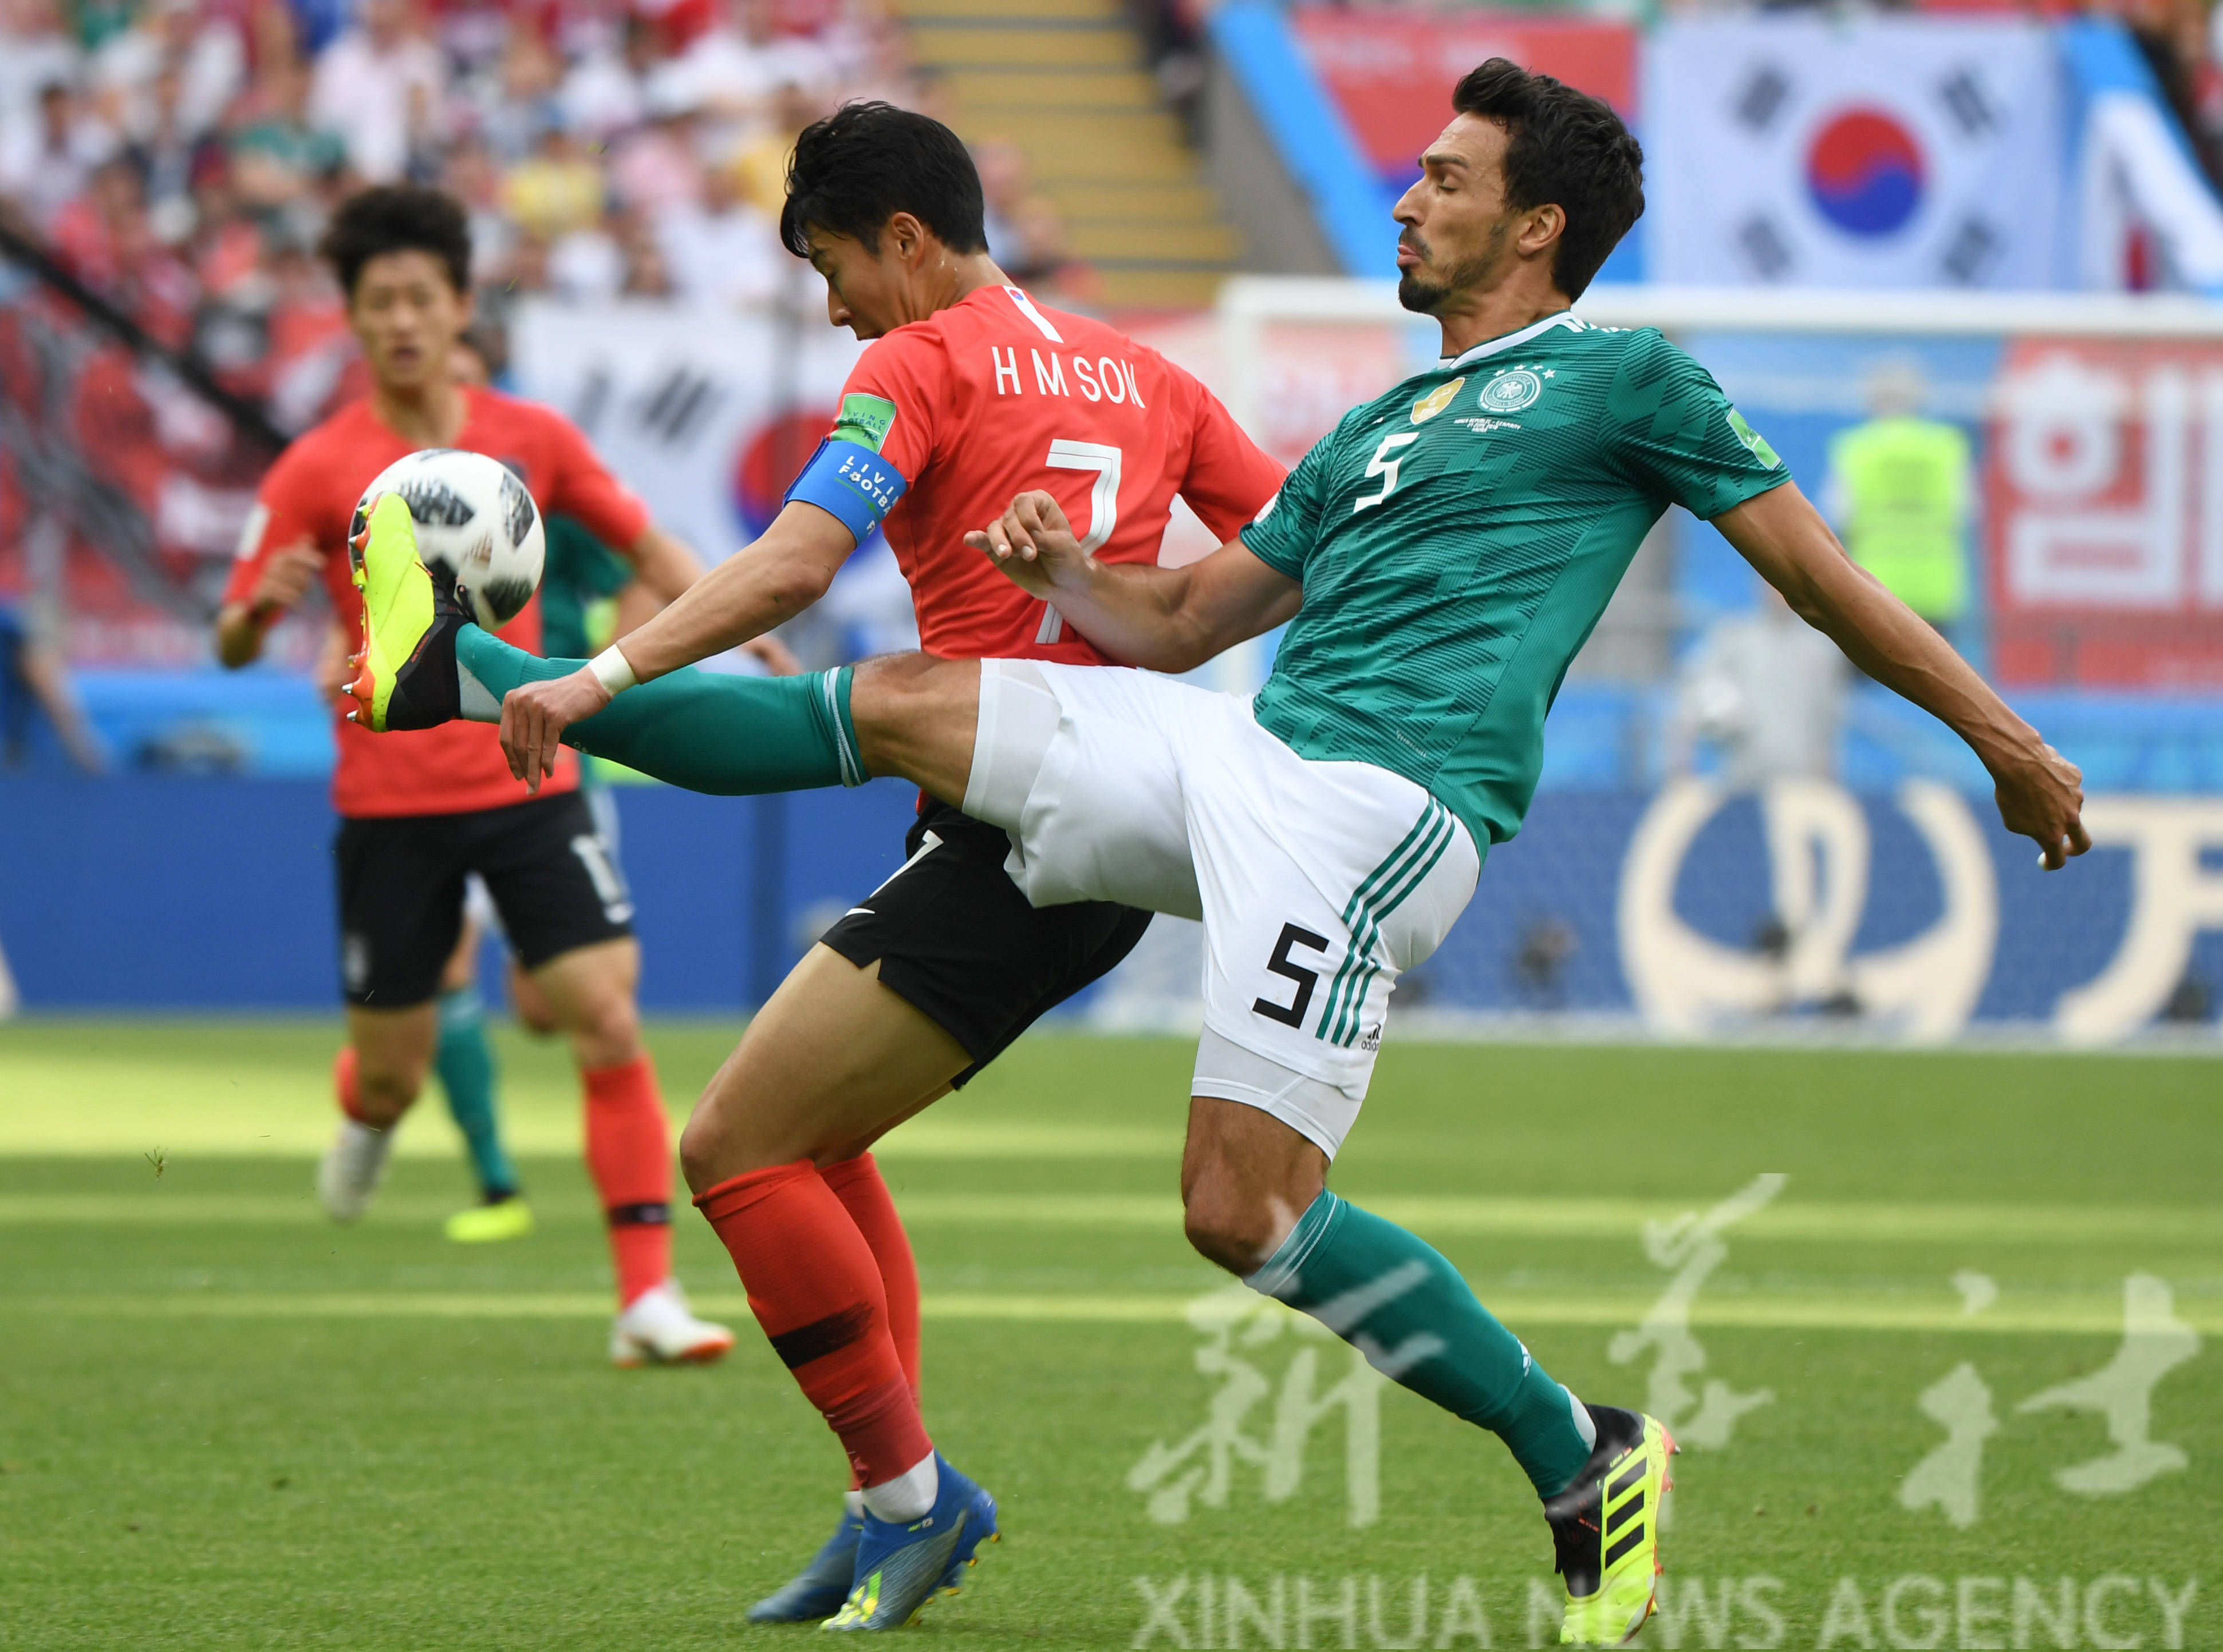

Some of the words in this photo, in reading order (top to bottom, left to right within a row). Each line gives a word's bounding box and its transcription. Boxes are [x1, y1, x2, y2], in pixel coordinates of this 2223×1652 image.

[991, 346, 1022, 395] H
[1031, 348, 1070, 397] M
[1073, 356, 1146, 408] SON
[1353, 432, 1420, 513] 5
[1034, 438, 1122, 644] 7
[1252, 921, 1330, 1030] 5
